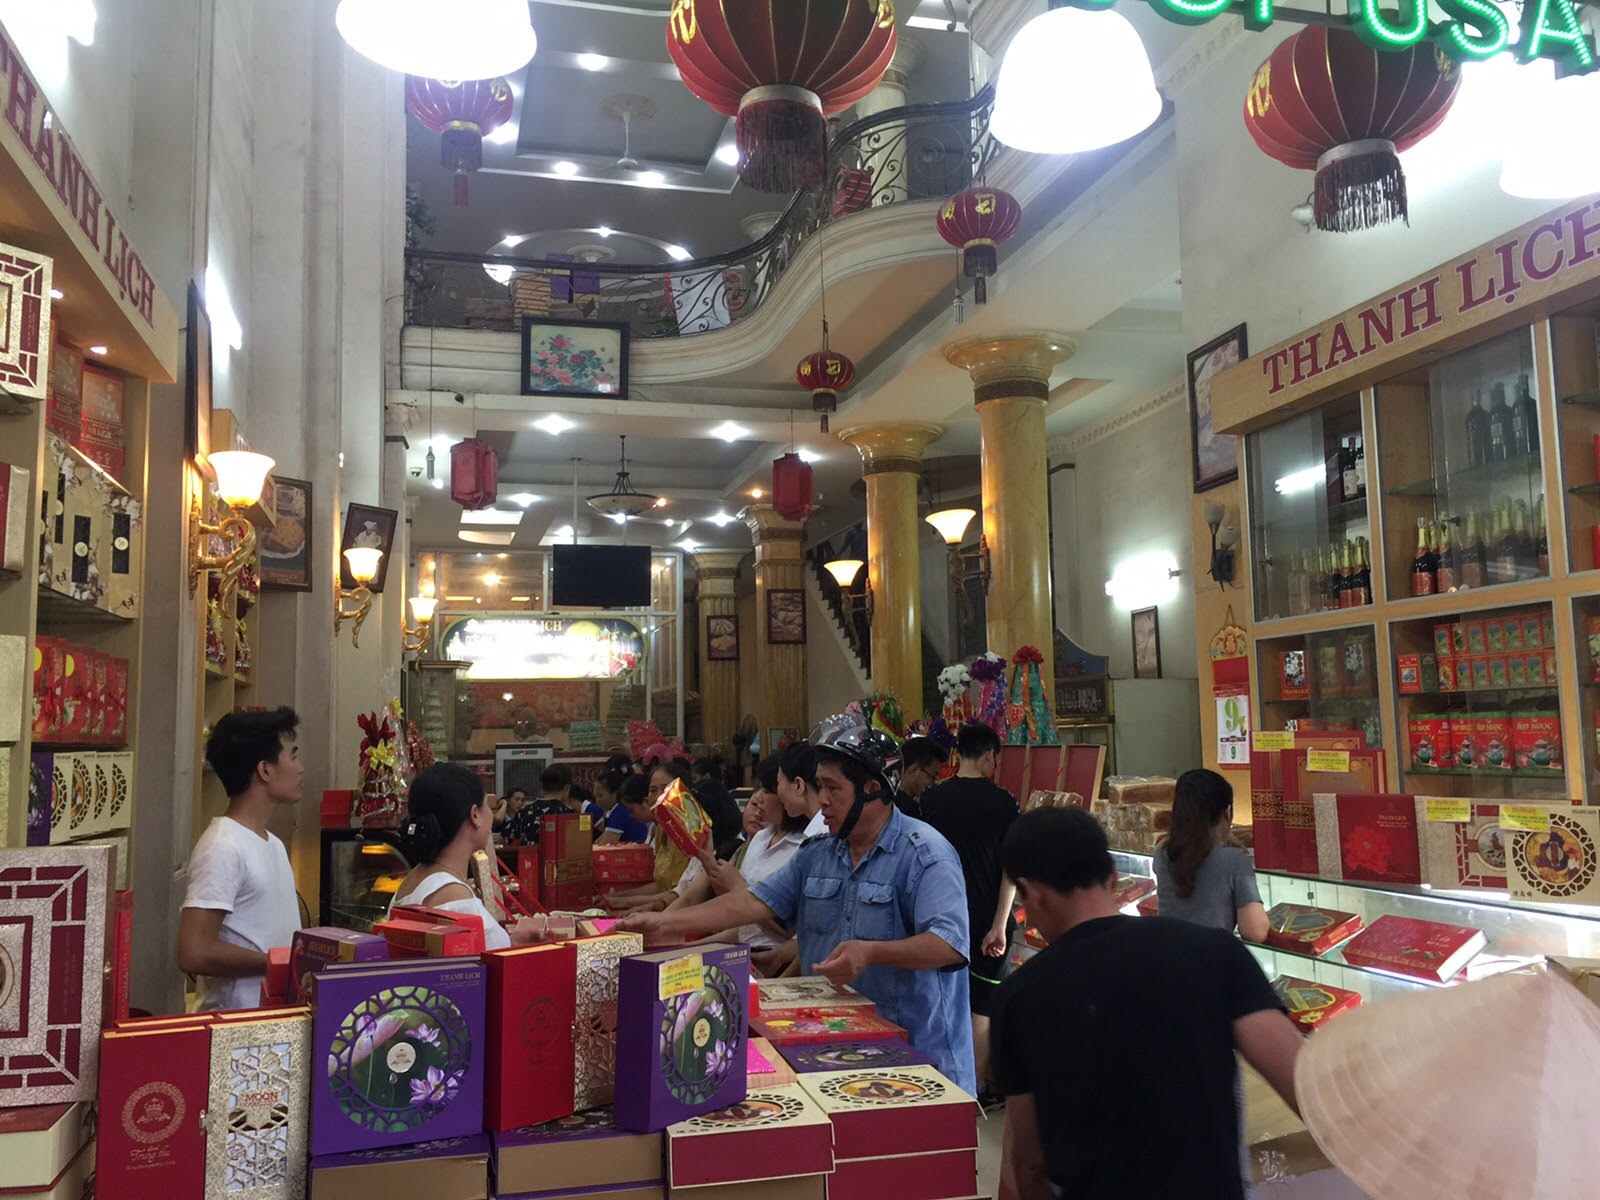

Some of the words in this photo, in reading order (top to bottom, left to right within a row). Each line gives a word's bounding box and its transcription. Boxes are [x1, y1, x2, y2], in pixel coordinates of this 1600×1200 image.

[1355, 0, 1595, 66] USA
[104, 209, 156, 330] LỊCH
[1262, 275, 1443, 396] THANH
[1455, 206, 1600, 314] LỊCH
[1225, 698, 1239, 732] 9
[1231, 745, 1237, 760] 9
[245, 1092, 278, 1102] MOON
